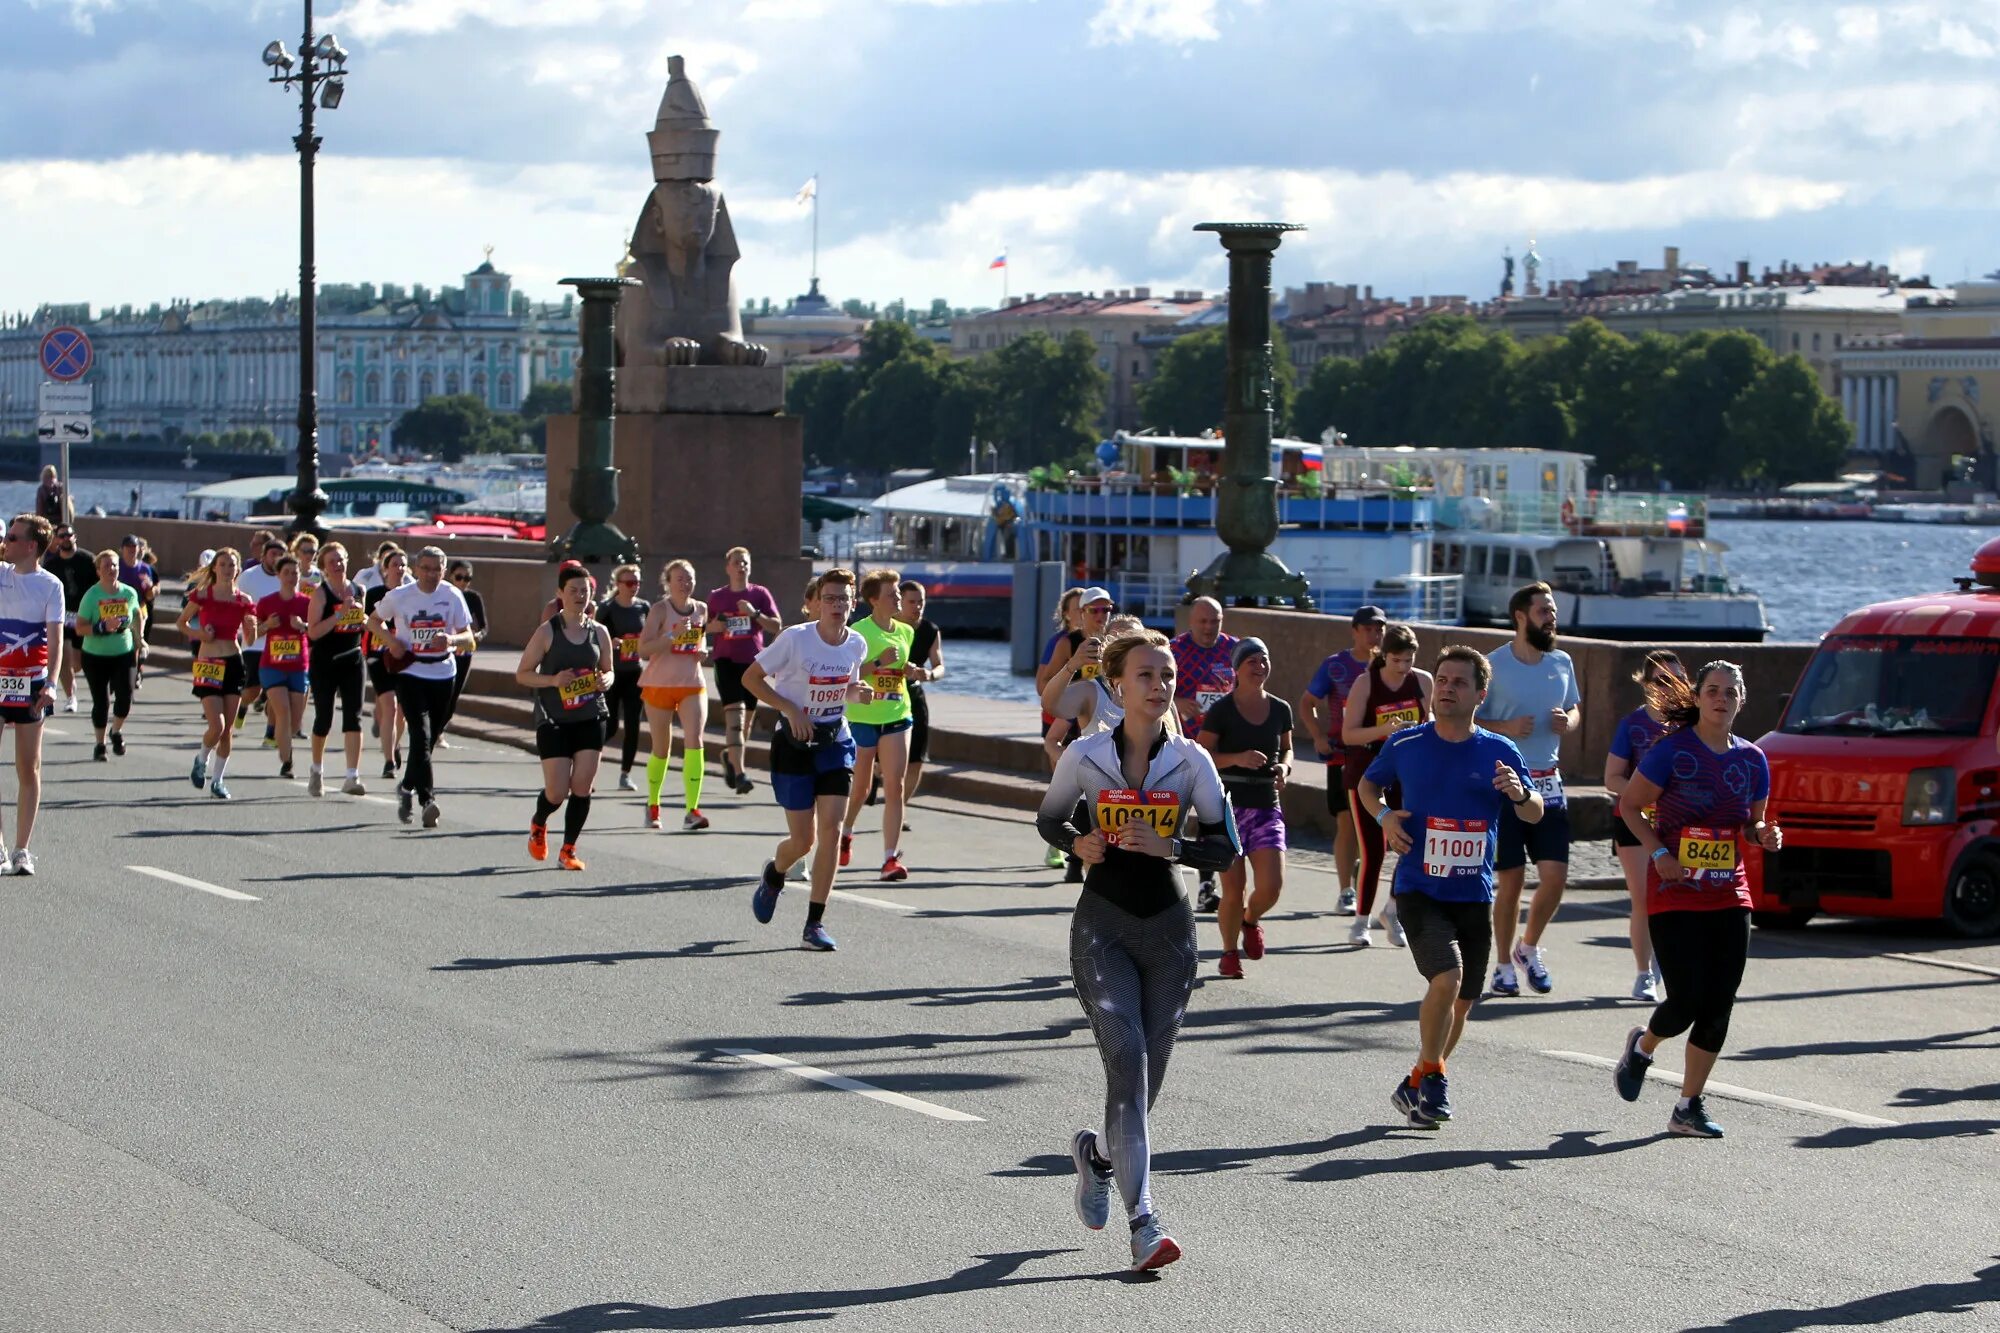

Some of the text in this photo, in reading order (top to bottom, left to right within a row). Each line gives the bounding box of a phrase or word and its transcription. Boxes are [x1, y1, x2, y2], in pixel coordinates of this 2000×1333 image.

[196, 664, 220, 676] 7236
[0, 677, 25, 690] 336
[810, 688, 846, 702] 10987
[1108, 833, 1117, 844] D
[1429, 837, 1483, 858] 11001
[1686, 841, 1730, 861] 8462
[1431, 865, 1439, 875] D
[1710, 871, 1719, 879] 10
